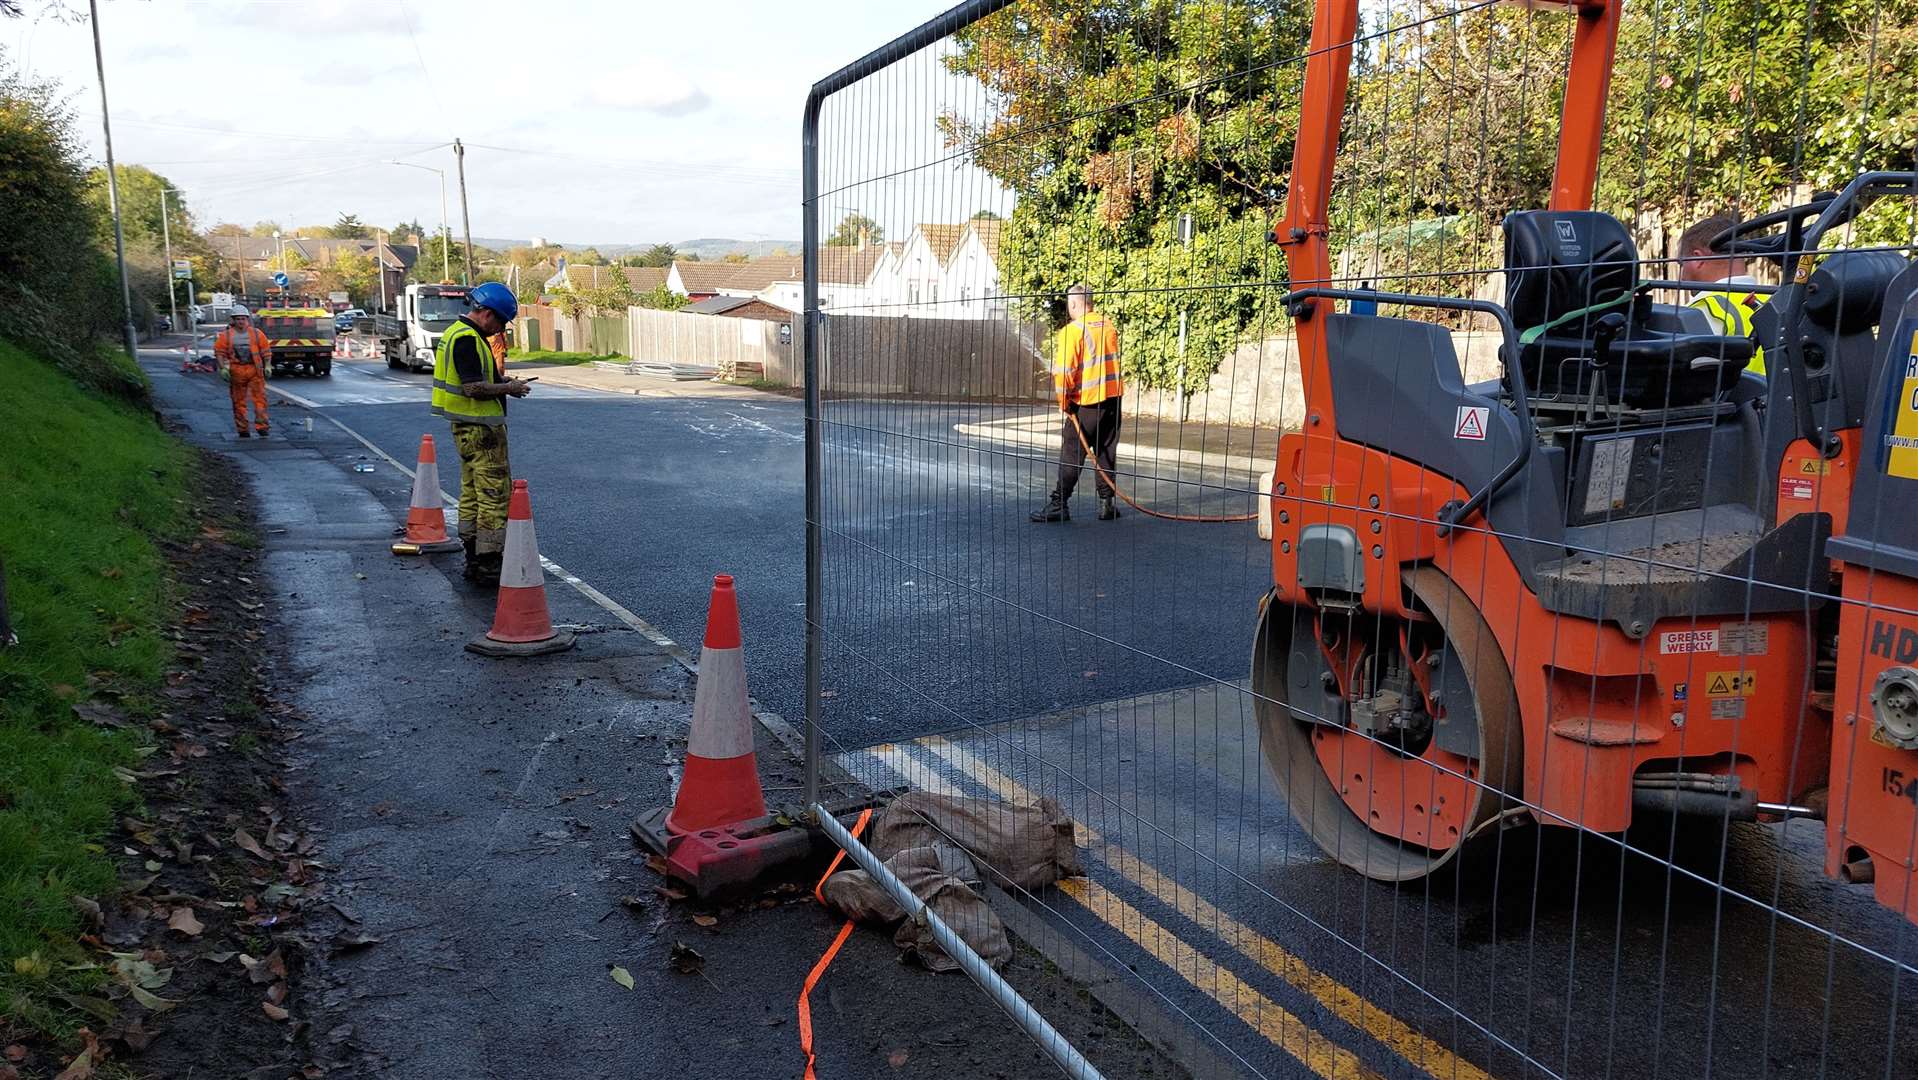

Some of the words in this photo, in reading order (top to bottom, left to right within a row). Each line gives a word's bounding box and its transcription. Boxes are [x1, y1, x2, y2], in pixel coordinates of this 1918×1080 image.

[1667, 631, 1713, 643] GREASE
[1871, 620, 1918, 664] HD
[1667, 641, 1713, 653] WEEKLY
